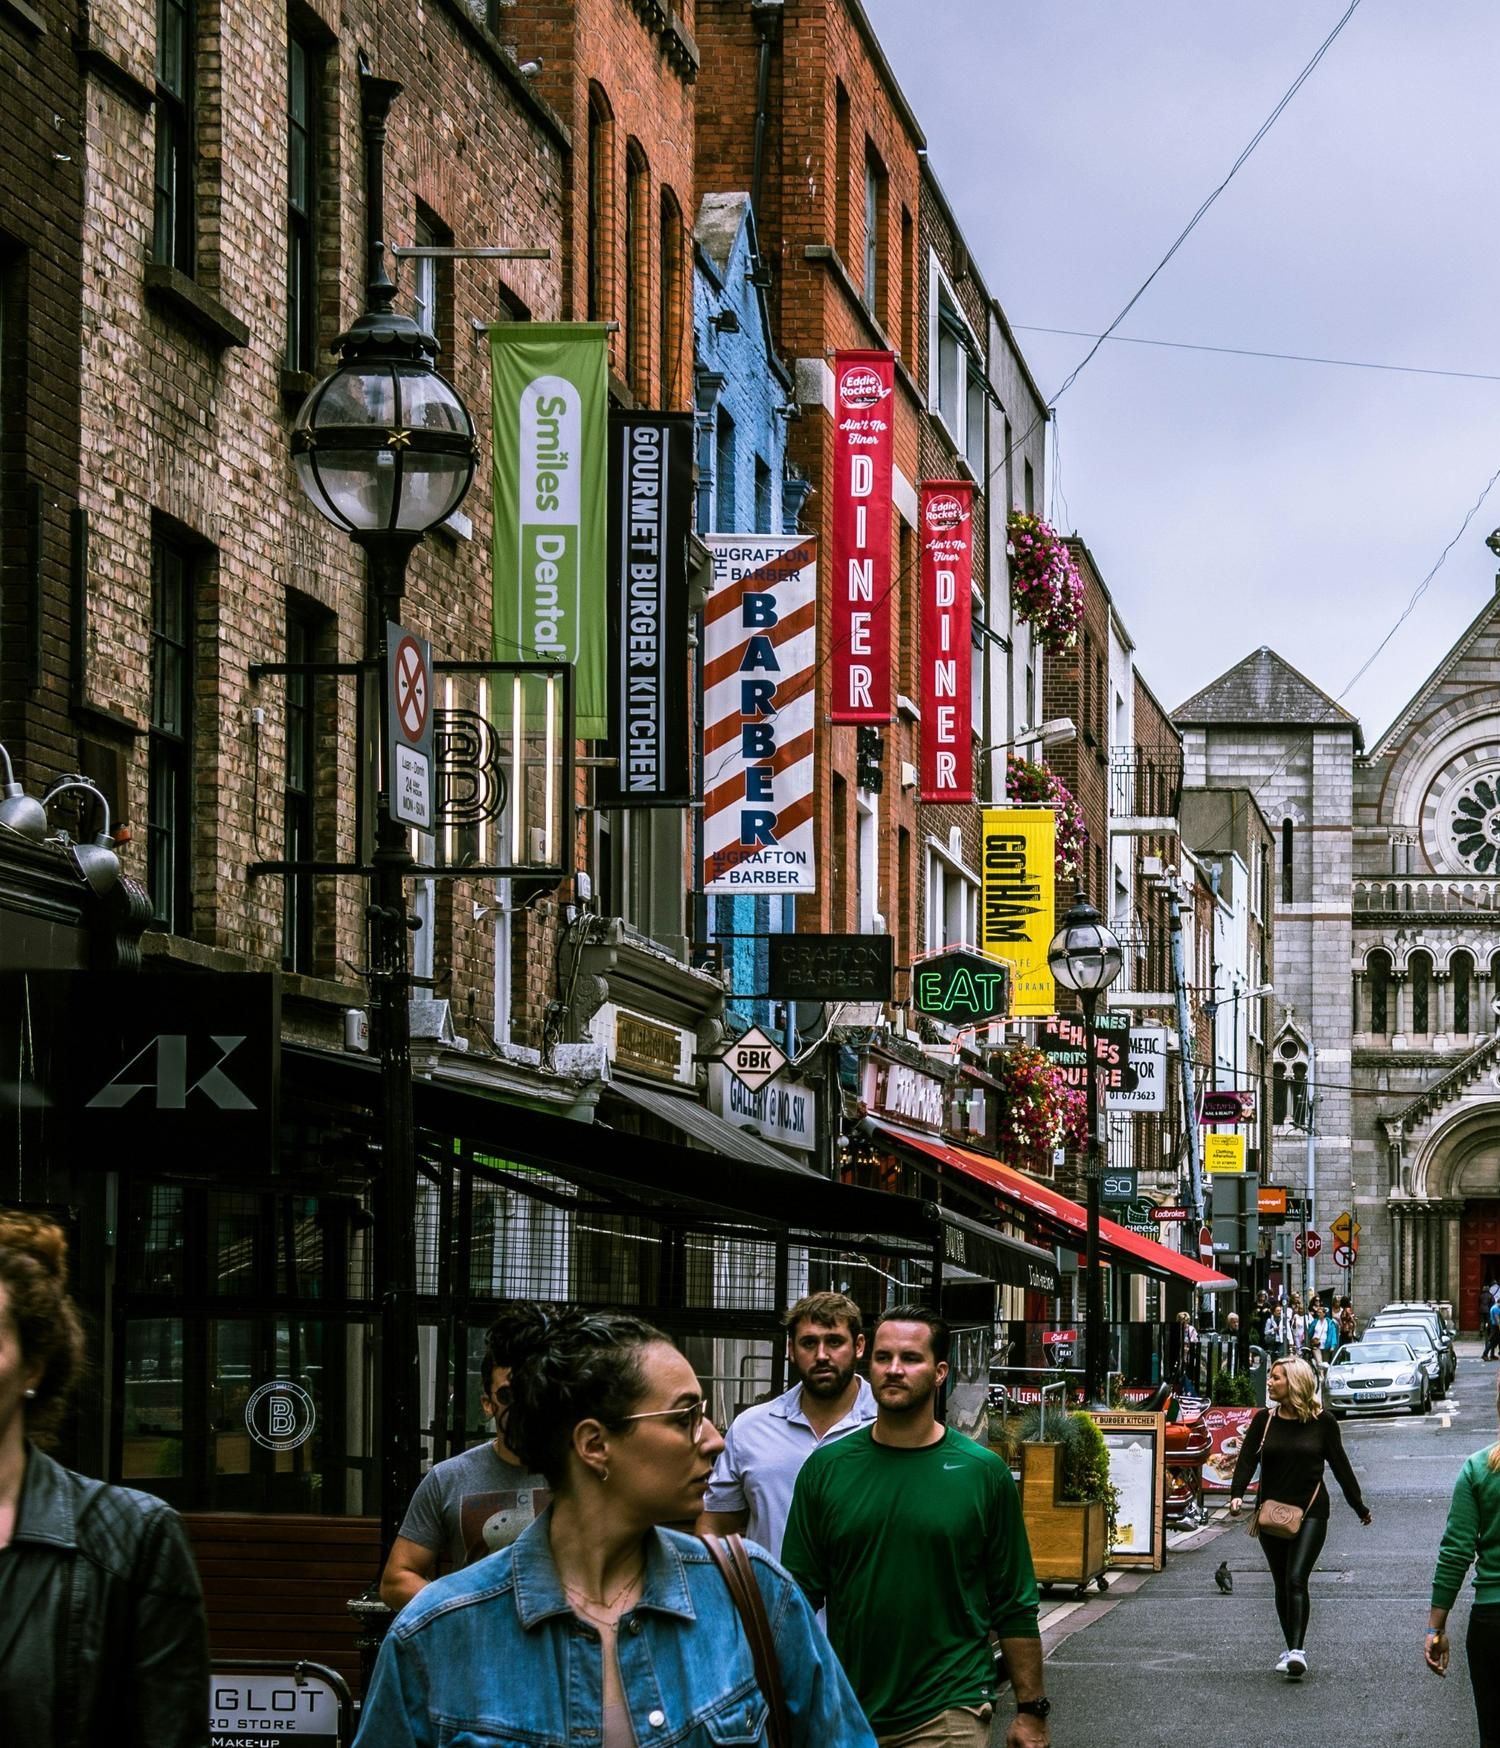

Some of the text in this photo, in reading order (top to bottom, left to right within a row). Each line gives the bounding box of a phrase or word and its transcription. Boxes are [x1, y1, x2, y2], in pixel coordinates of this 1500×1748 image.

[846, 374, 877, 387] Eddie
[839, 418, 888, 433] Ain't No
[848, 432, 879, 445] Finer
[931, 501, 958, 513] Eddie
[533, 395, 567, 653] Smiles Dental
[926, 538, 950, 551] Ain't
[714, 547, 728, 580] THE
[728, 548, 809, 562] GRAFTON
[933, 551, 960, 563] Finer
[731, 567, 801, 583] BARBER
[848, 454, 873, 708] DINER
[629, 425, 660, 792] GOURMET BURGER KITCHEN
[935, 569, 957, 789] DINER
[739, 591, 781, 847] BARBER
[723, 850, 807, 865] GRAFTON
[713, 851, 726, 884] THE
[730, 870, 800, 884] BARBER
[985, 834, 1047, 942] GOTHAM
[781, 945, 882, 964] GRAFTON
[788, 969, 875, 986] BARBER
[918, 967, 1002, 1013] EAT
[1093, 1015, 1127, 1029] INES
[1129, 1037, 1160, 1055] METIC
[737, 1050, 772, 1069] GBK
[85, 1034, 258, 1110] AK
[770, 1088, 777, 1126] @
[793, 1095, 805, 1133] SIX
[1104, 1179, 1132, 1193] SO
[1154, 1210, 1187, 1219] Ladbrokes
[1296, 1239, 1321, 1249] SOP
[269, 1396, 296, 1436] B
[1099, 1416, 1155, 1425] BURGER KITCHEN
[215, 1688, 324, 1713] GLOT
[209, 1718, 296, 1730] RO STORE
